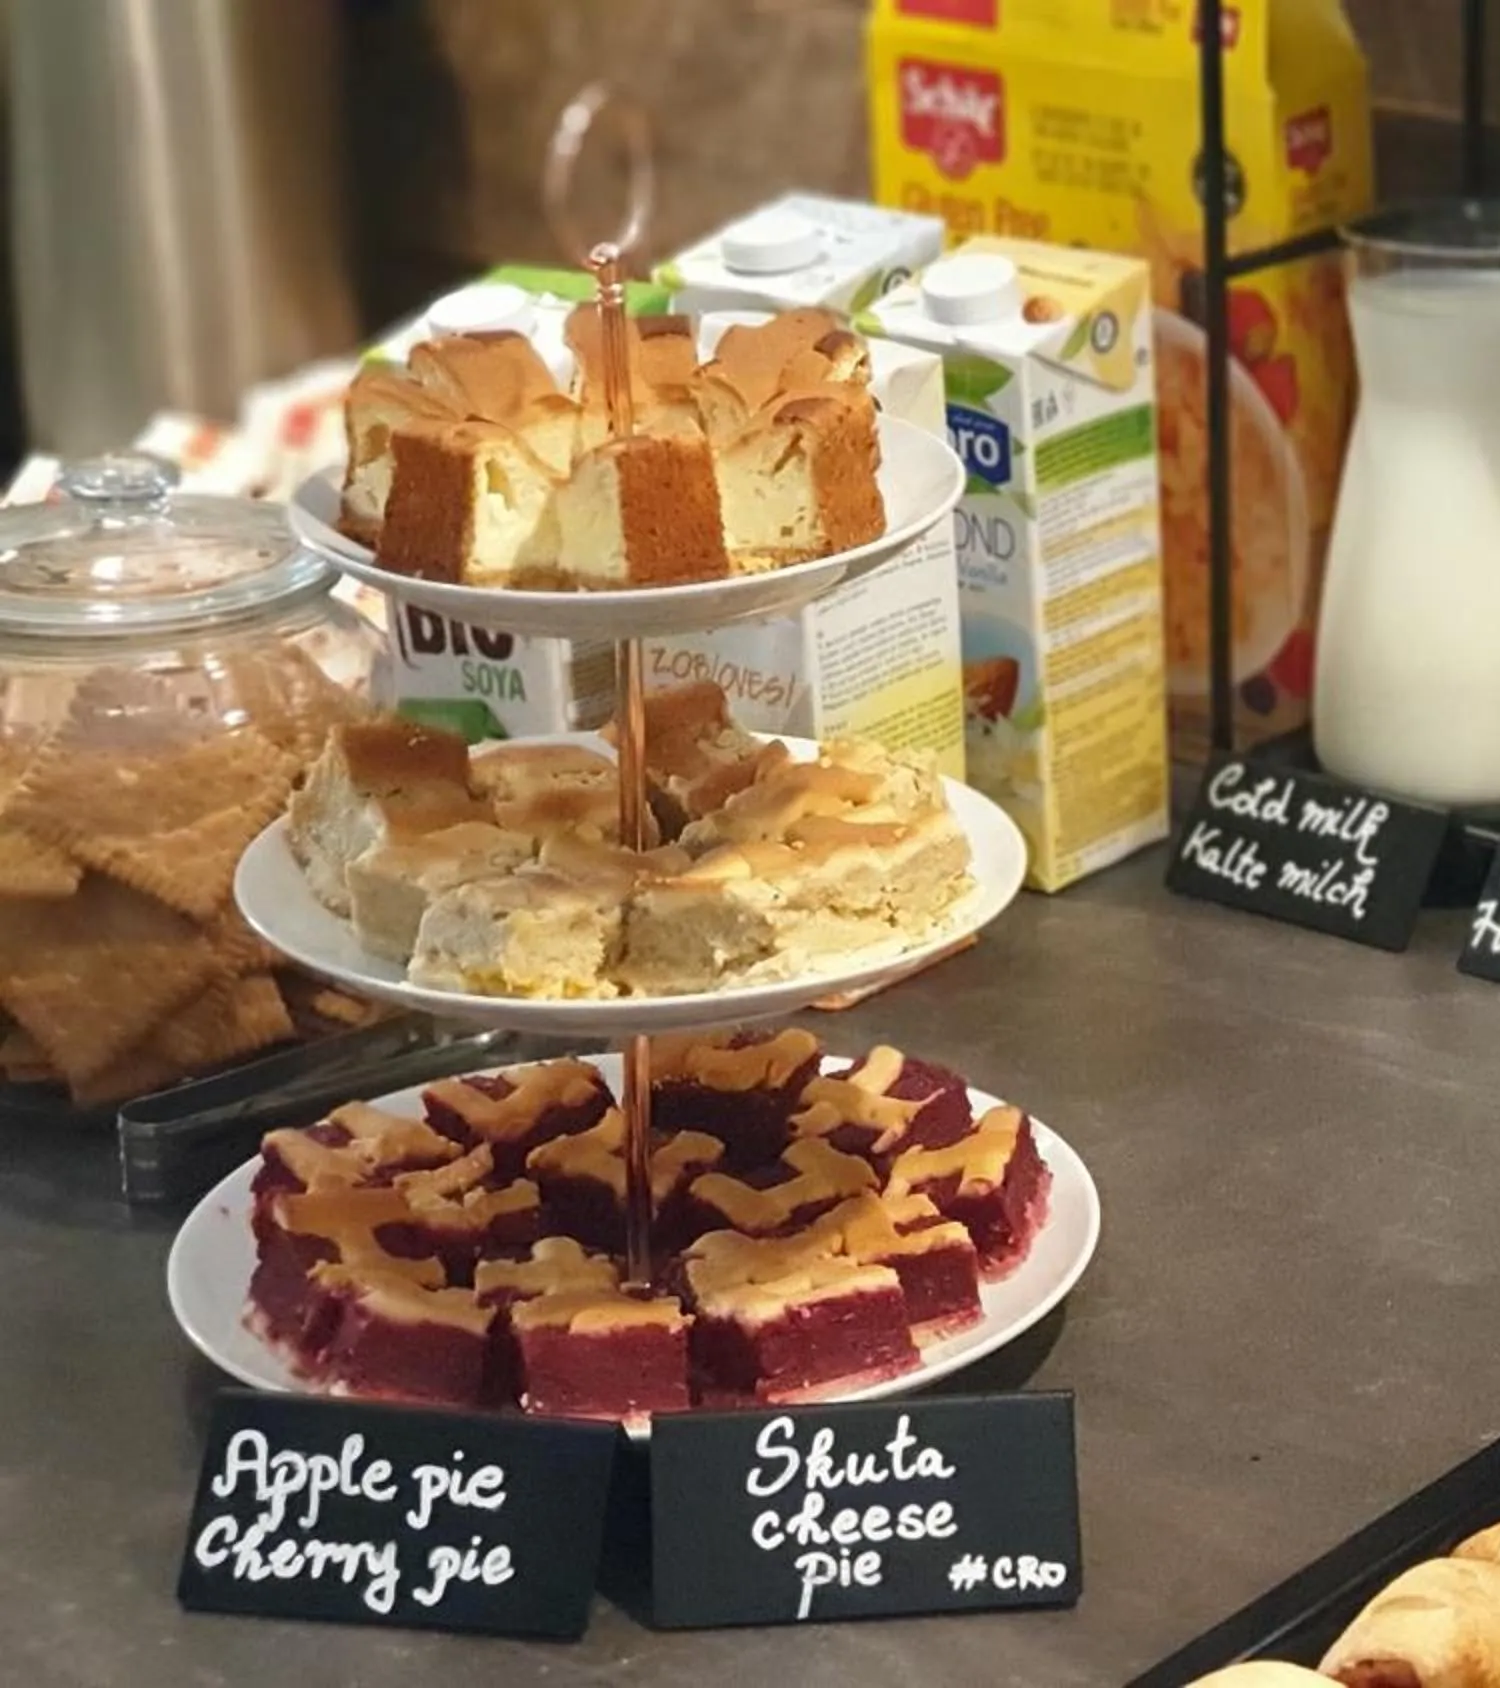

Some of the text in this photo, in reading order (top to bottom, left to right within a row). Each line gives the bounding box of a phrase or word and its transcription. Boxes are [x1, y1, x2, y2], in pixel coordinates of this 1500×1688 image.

[462, 660, 526, 702] SOYA
[1208, 763, 1295, 825] Cold
[1298, 796, 1389, 866] milk
[1182, 821, 1376, 920] Kalte milch
[211, 1429, 507, 1532] Apple pie
[746, 1414, 956, 1497] Skuta
[194, 1513, 515, 1614] Cherry pie
[751, 1491, 958, 1551] cheese
[795, 1547, 1067, 1619] pie #CRO
